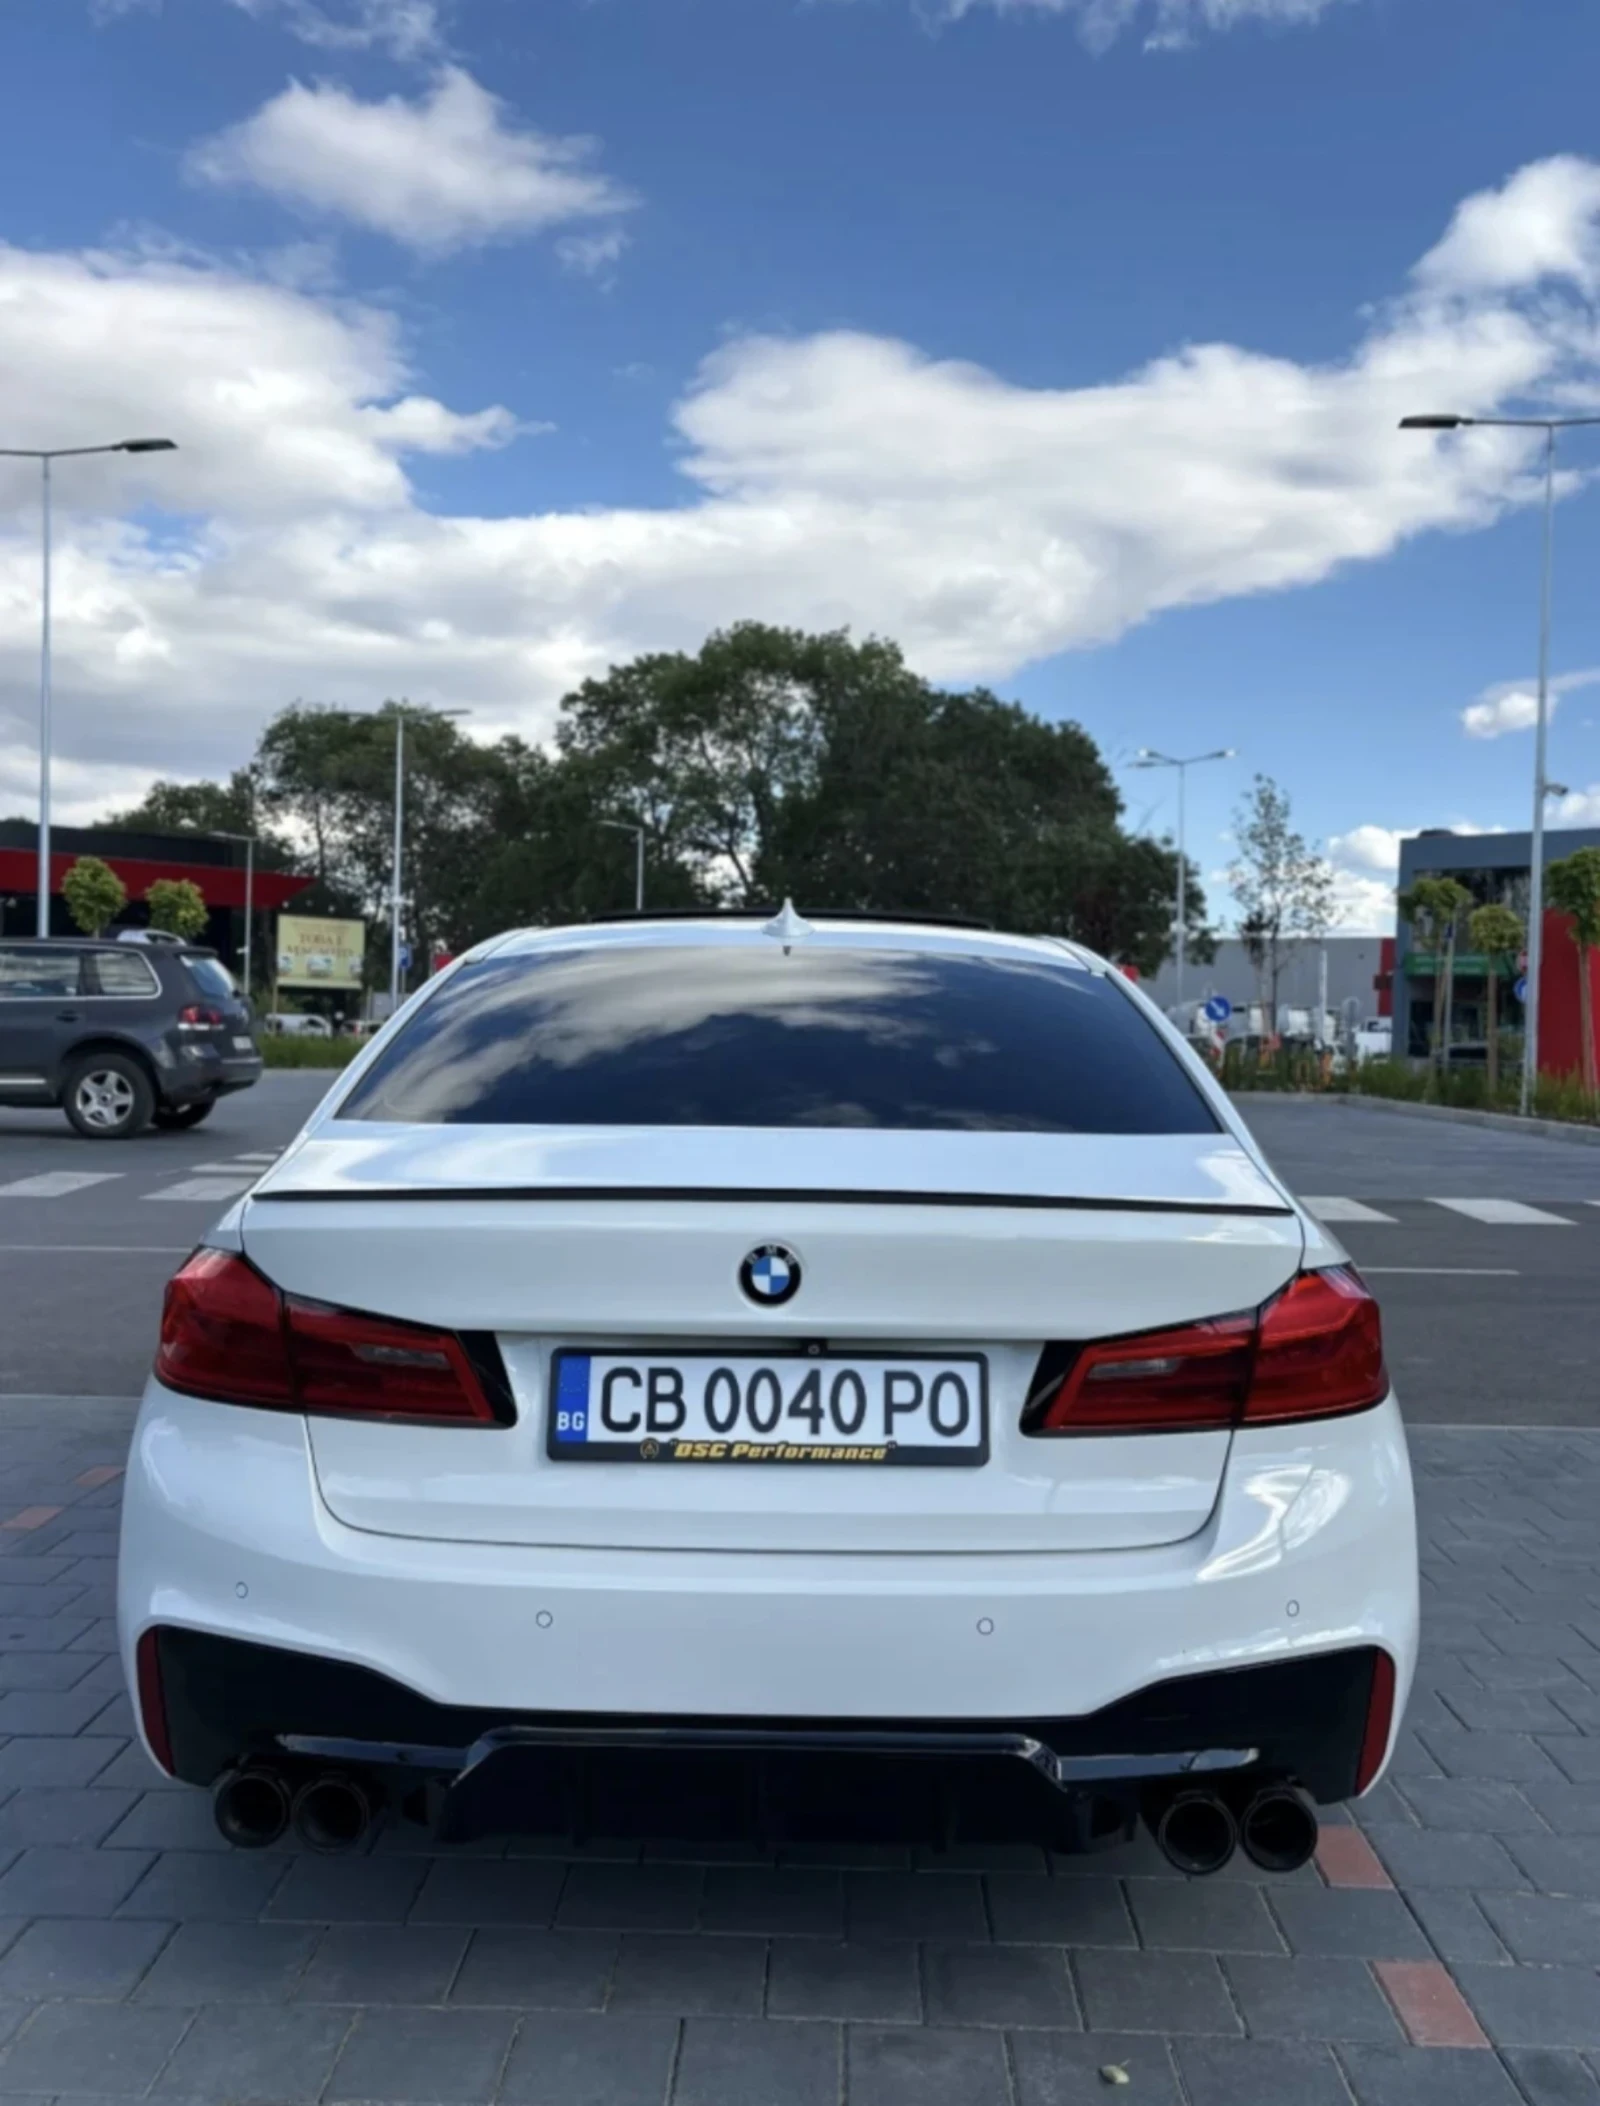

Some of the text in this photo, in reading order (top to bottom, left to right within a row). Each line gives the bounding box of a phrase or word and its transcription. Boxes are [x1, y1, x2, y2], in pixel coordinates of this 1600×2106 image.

[557, 1411, 585, 1432] BG
[601, 1366, 687, 1433] CB
[704, 1366, 867, 1435] 0040
